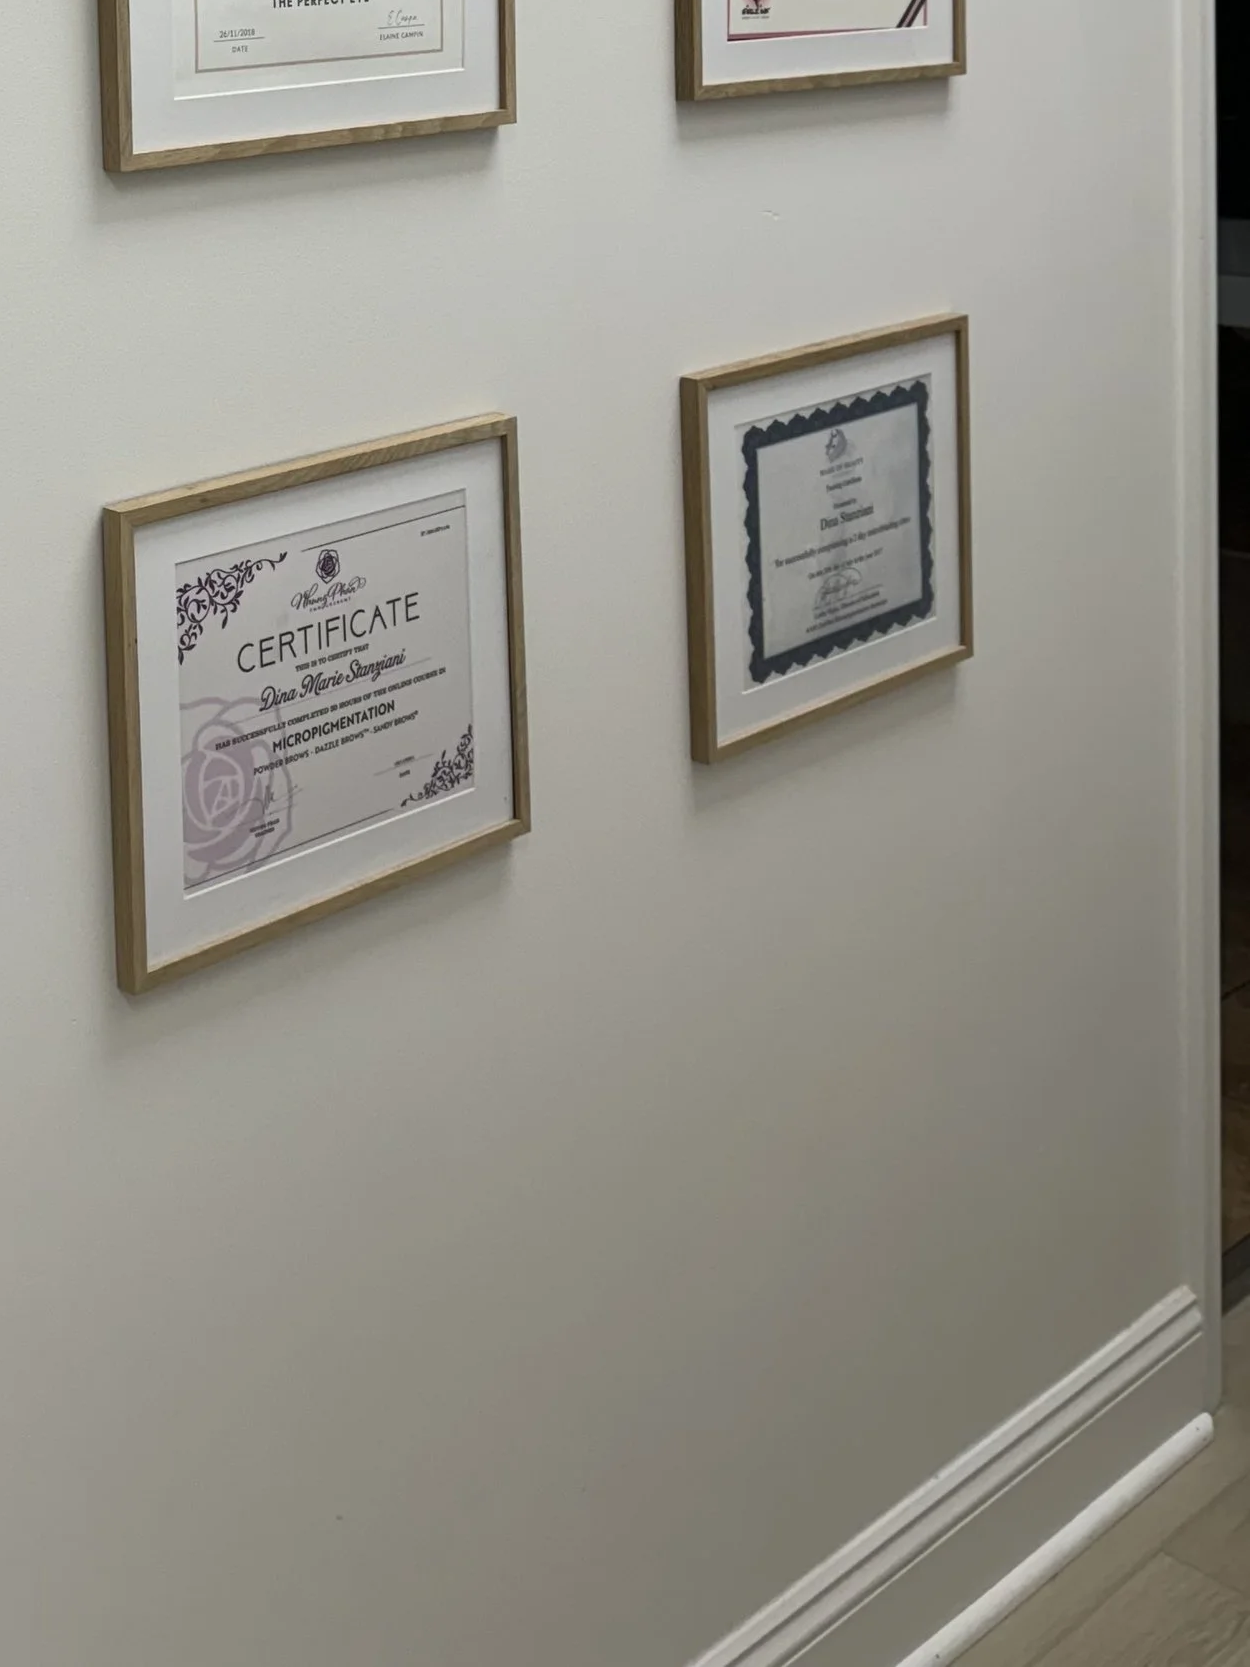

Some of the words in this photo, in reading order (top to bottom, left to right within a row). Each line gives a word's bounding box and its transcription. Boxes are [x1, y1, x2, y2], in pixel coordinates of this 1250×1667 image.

[231, 45, 249, 54] DATE
[237, 591, 421, 673] CERTIFICATE
[259, 686, 297, 712] Dina
[299, 673, 344, 698] Marie
[346, 648, 407, 682] Stanziani
[272, 699, 395, 754] MICROPIGMENTATION
